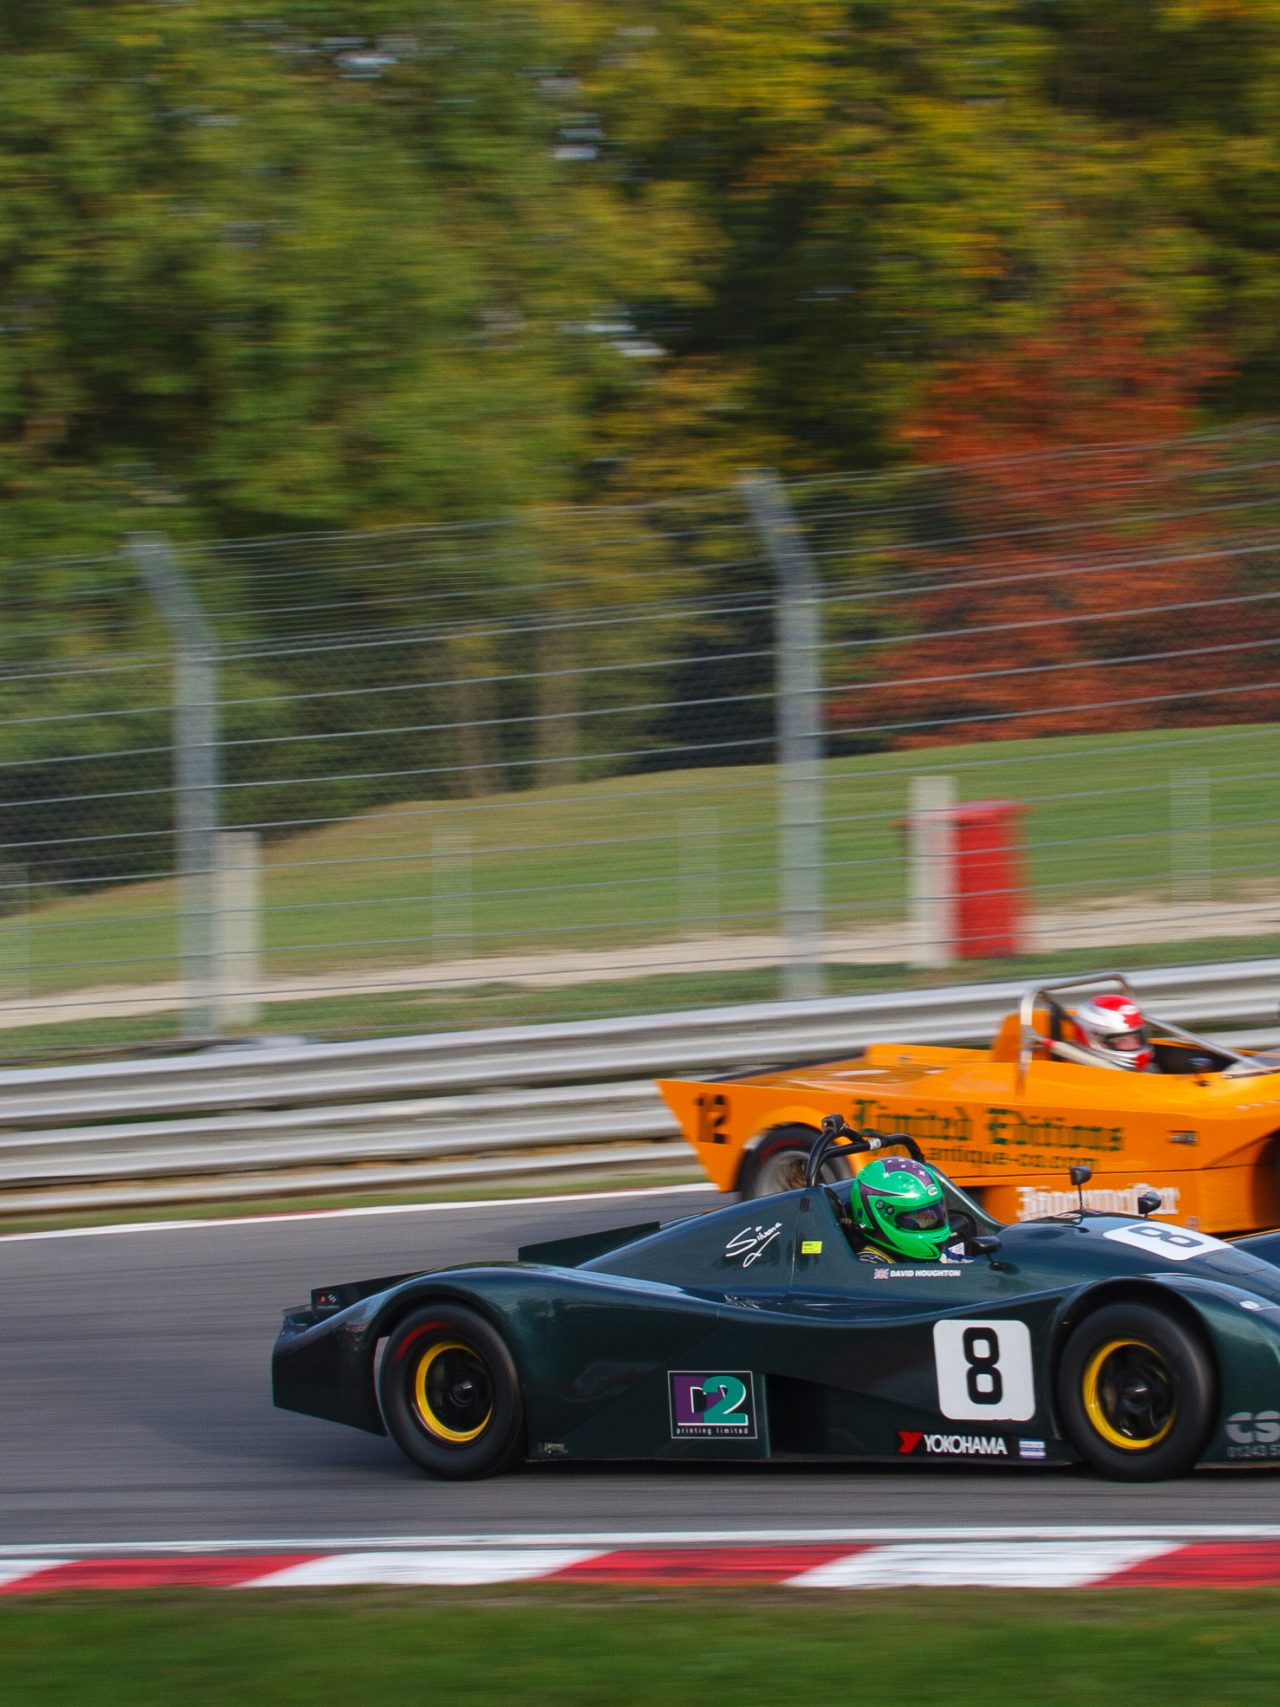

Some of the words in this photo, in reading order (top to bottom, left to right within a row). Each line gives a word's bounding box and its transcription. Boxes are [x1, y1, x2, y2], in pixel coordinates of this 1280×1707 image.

[695, 1093, 731, 1145] 12
[1128, 1226, 1204, 1248] 8
[890, 1269, 914, 1277] DAVID
[915, 1268, 961, 1277] HOUGHTON
[962, 1327, 1003, 1405] 8
[676, 1426, 712, 1435] printing
[716, 1425, 748, 1434] limited
[923, 1434, 1008, 1455] YOKOHAMA
